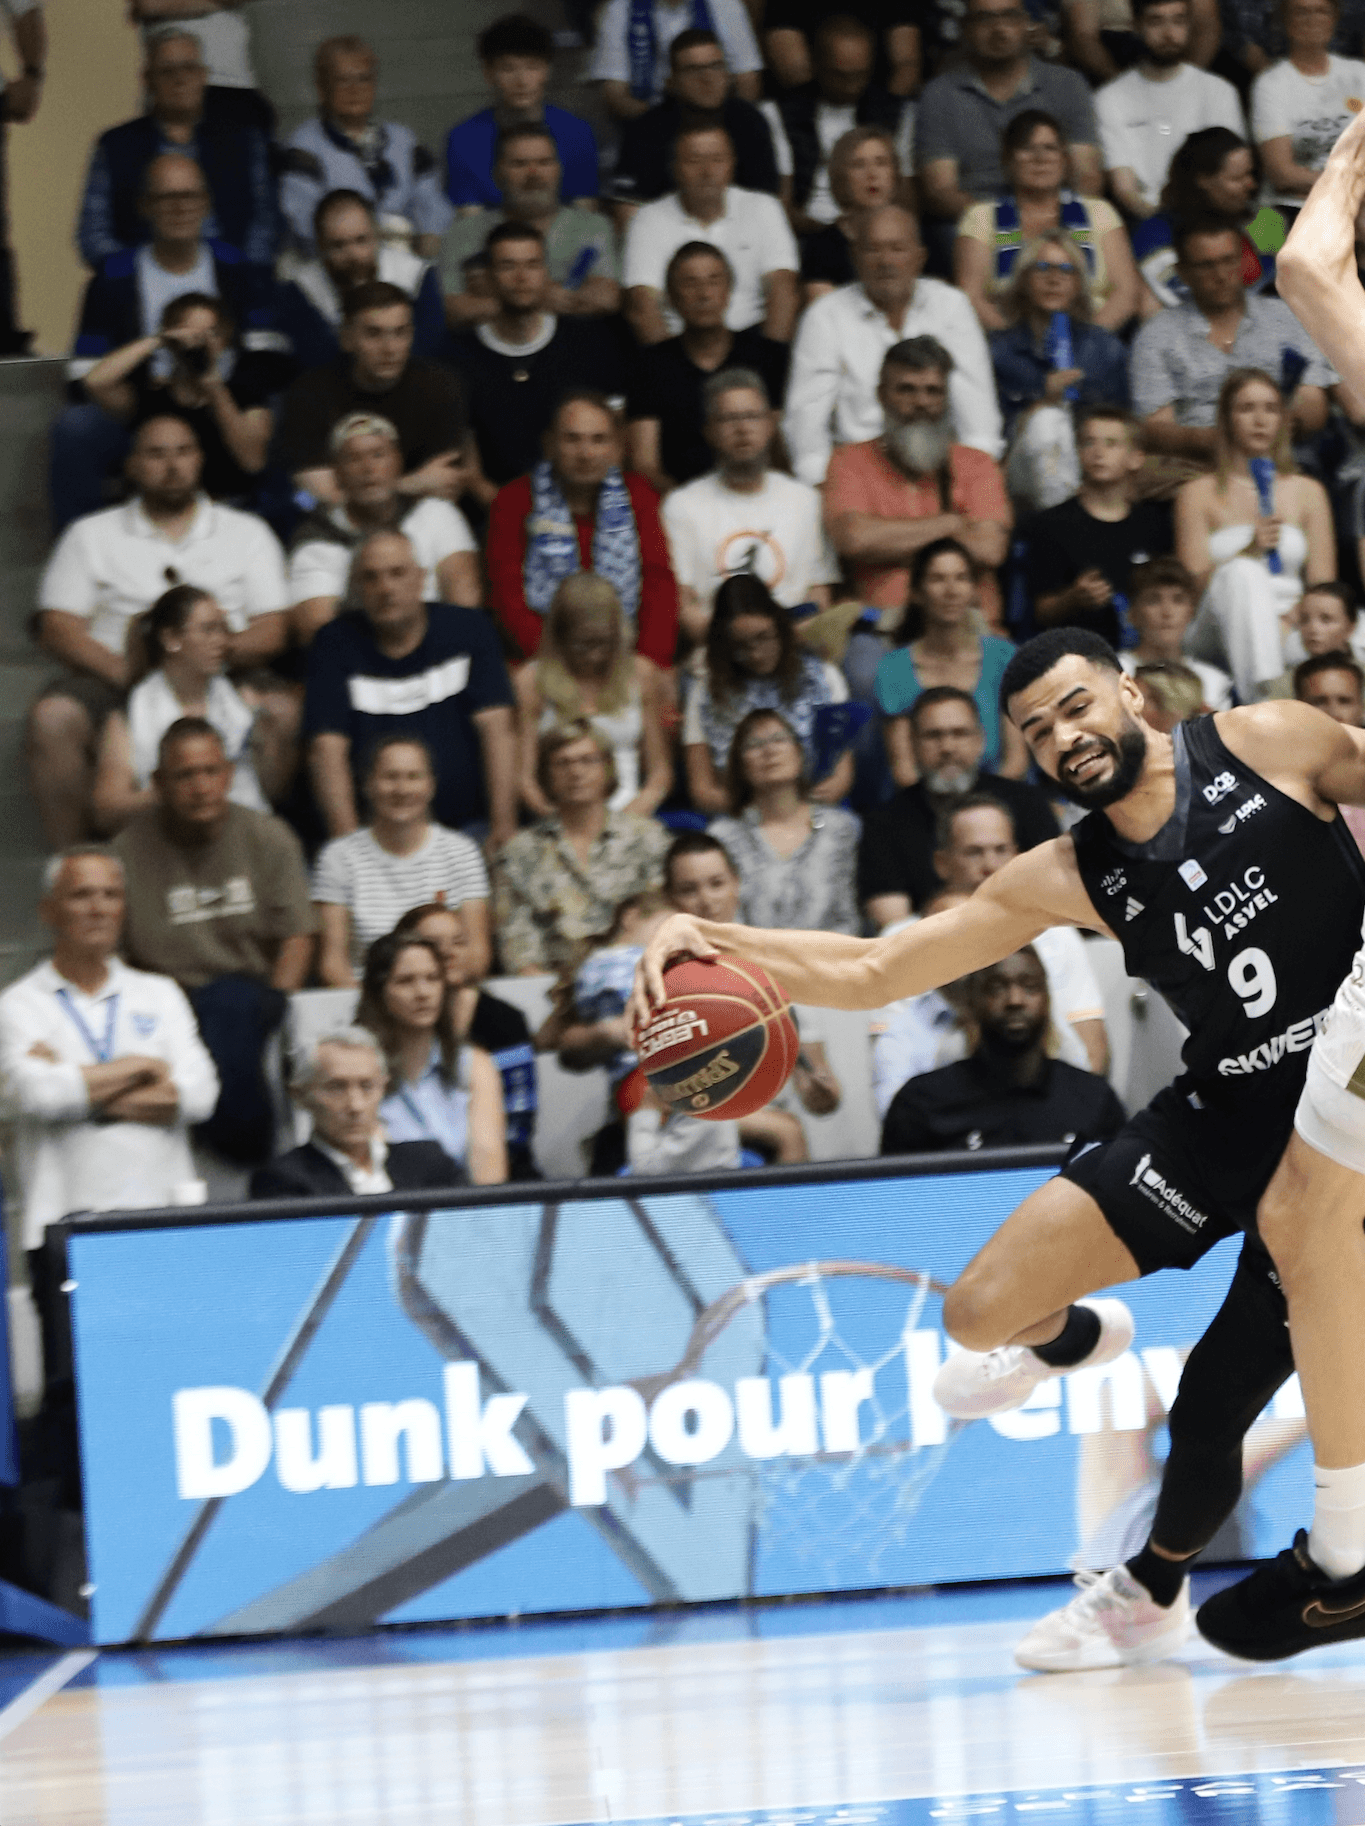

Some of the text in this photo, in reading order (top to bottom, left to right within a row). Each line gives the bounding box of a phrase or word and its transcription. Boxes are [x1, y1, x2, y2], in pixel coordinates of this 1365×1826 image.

[1203, 866, 1265, 925] LDLC
[1224, 888, 1279, 941] ASVEL
[1227, 947, 1278, 1019] 9
[1153, 1179, 1209, 1228] Adéquat
[173, 1360, 535, 1500] Dunk
[564, 1367, 873, 1506] pour
